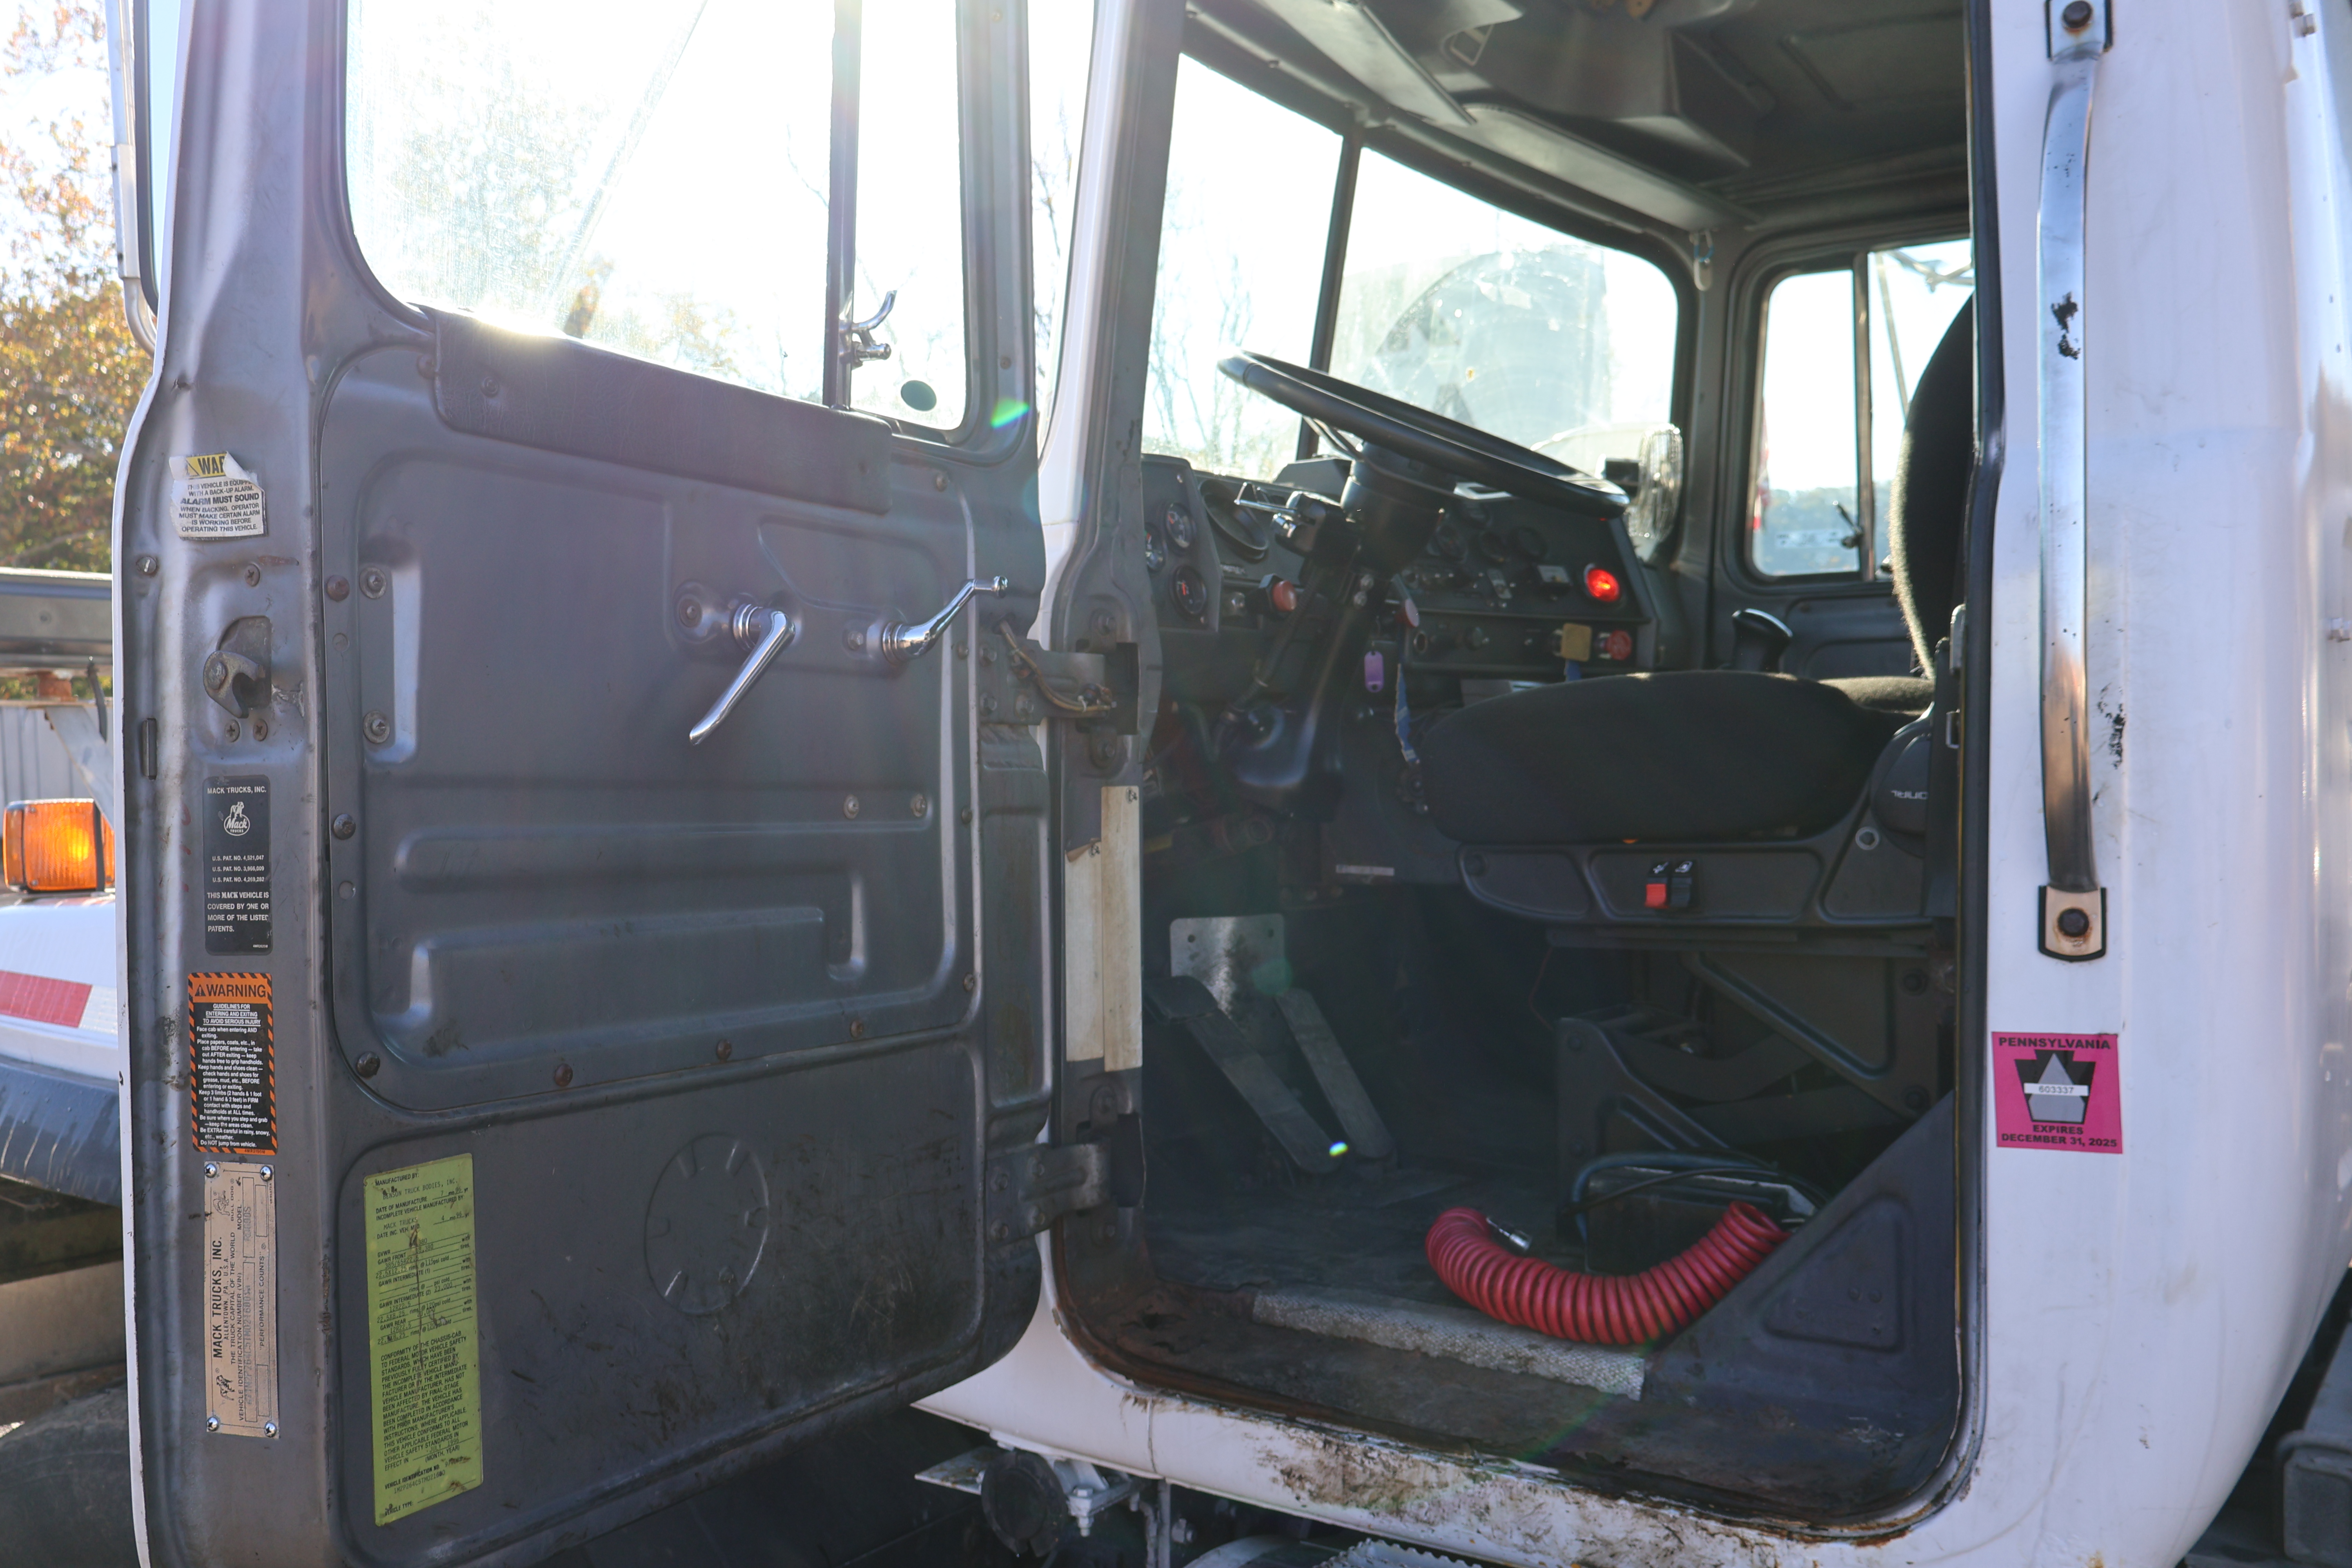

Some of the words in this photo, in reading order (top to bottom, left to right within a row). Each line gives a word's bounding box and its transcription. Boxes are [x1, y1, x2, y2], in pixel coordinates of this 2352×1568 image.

[213, 495, 233, 504] MUST
[234, 493, 259, 502] SOUND
[226, 818, 247, 829] Mack
[206, 984, 266, 997] WARNING
[1999, 1037, 2111, 1049] PENNSYLVANIA
[2039, 1085, 2074, 1094] 603337
[2033, 1125, 2084, 1134] EXPIRES
[2002, 1133, 2067, 1144] DECEMBER
[2070, 1137, 2085, 1147] 31,
[2089, 1138, 2117, 1147] 2025
[375, 1174, 411, 1186] MANUFACTURED
[405, 1186, 420, 1194] TRUCK
[423, 1181, 443, 1191] BODIES,
[376, 1209, 403, 1221] INCOMPLETE
[405, 1205, 421, 1214] VEHICLE
[423, 1197, 457, 1209] MANUFACTURED
[396, 1196, 427, 1209] MANUFACTURE
[400, 1217, 418, 1226] TRUCKS
[212, 1237, 222, 1260] INC.
[230, 1278, 235, 1288] OF
[212, 1267, 223, 1317] TRUCKS,
[212, 1325, 222, 1358] MACK
[381, 1347, 411, 1361] CONFORMITY
[431, 1331, 461, 1345] CHASSIS-CAB
[389, 1355, 410, 1366] FEDERAL
[429, 1343, 448, 1354] VEHICLE
[449, 1336, 467, 1347] SAFETY
[385, 1479, 400, 1489] VEHICLE
[402, 1467, 432, 1483] IDENTIFICATION
[385, 1505, 401, 1515] VEHICLE
